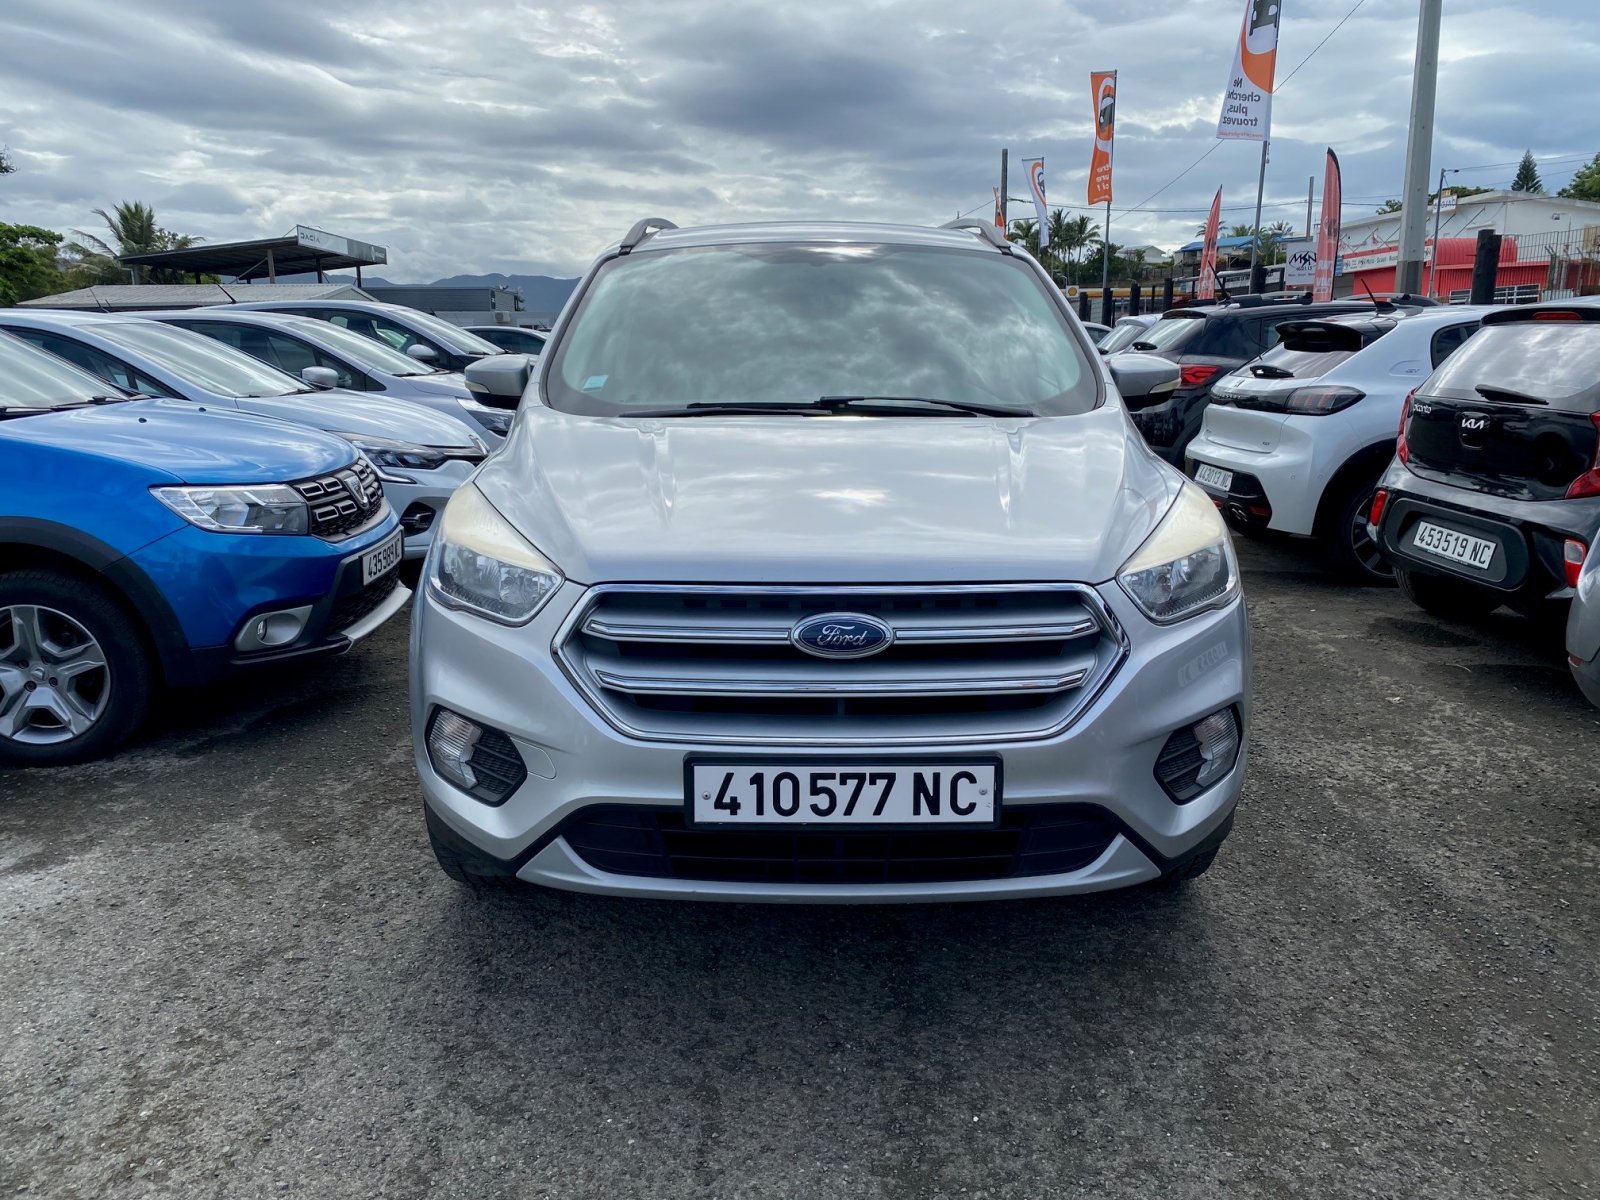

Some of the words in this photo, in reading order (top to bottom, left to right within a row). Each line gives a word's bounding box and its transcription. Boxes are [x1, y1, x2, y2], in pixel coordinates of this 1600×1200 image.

[300, 232, 321, 245] DACIA
[1461, 418, 1485, 430] KIA
[1418, 525, 1469, 558] 453519
[1469, 541, 1491, 564] NC
[816, 624, 868, 646] Ford
[713, 771, 897, 818] 410577
[912, 771, 979, 817] NC
